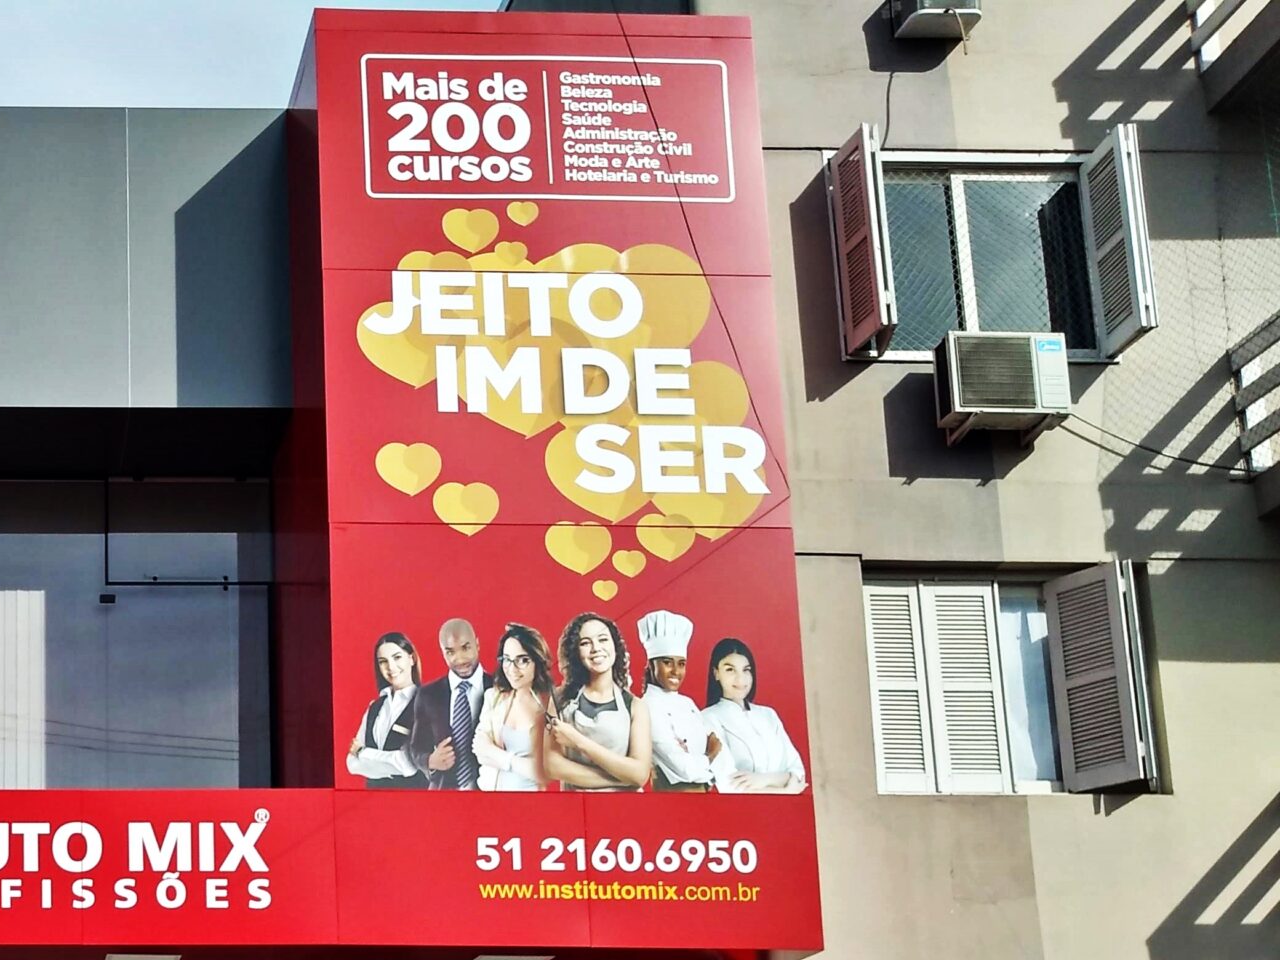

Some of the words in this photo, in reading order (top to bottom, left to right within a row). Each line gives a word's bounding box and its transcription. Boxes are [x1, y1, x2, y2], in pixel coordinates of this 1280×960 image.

[382, 72, 469, 100] Mais
[478, 73, 528, 101] de
[559, 72, 661, 87] Gastronomia
[561, 86, 612, 99] Beleza
[561, 100, 647, 114] Tecnologia
[387, 102, 531, 153] 200
[561, 112, 611, 126] Saúde
[562, 127, 677, 144] Administração
[564, 141, 654, 156] Construção
[660, 142, 692, 155] Civil
[387, 155, 532, 182] cursos
[564, 155, 609, 168] Moda
[611, 158, 620, 168] e
[626, 156, 660, 169] Arte
[565, 169, 637, 183] Hotelaria
[640, 173, 650, 183] e
[654, 170, 719, 185] Turismo
[363, 270, 643, 338] JEITO
[436, 345, 542, 414] IM
[561, 347, 695, 415] DE
[574, 423, 771, 494] SER
[476, 837, 522, 871] 51
[540, 838, 758, 874] 2160.6950
[479, 880, 760, 903] www.institutomix.com.br
